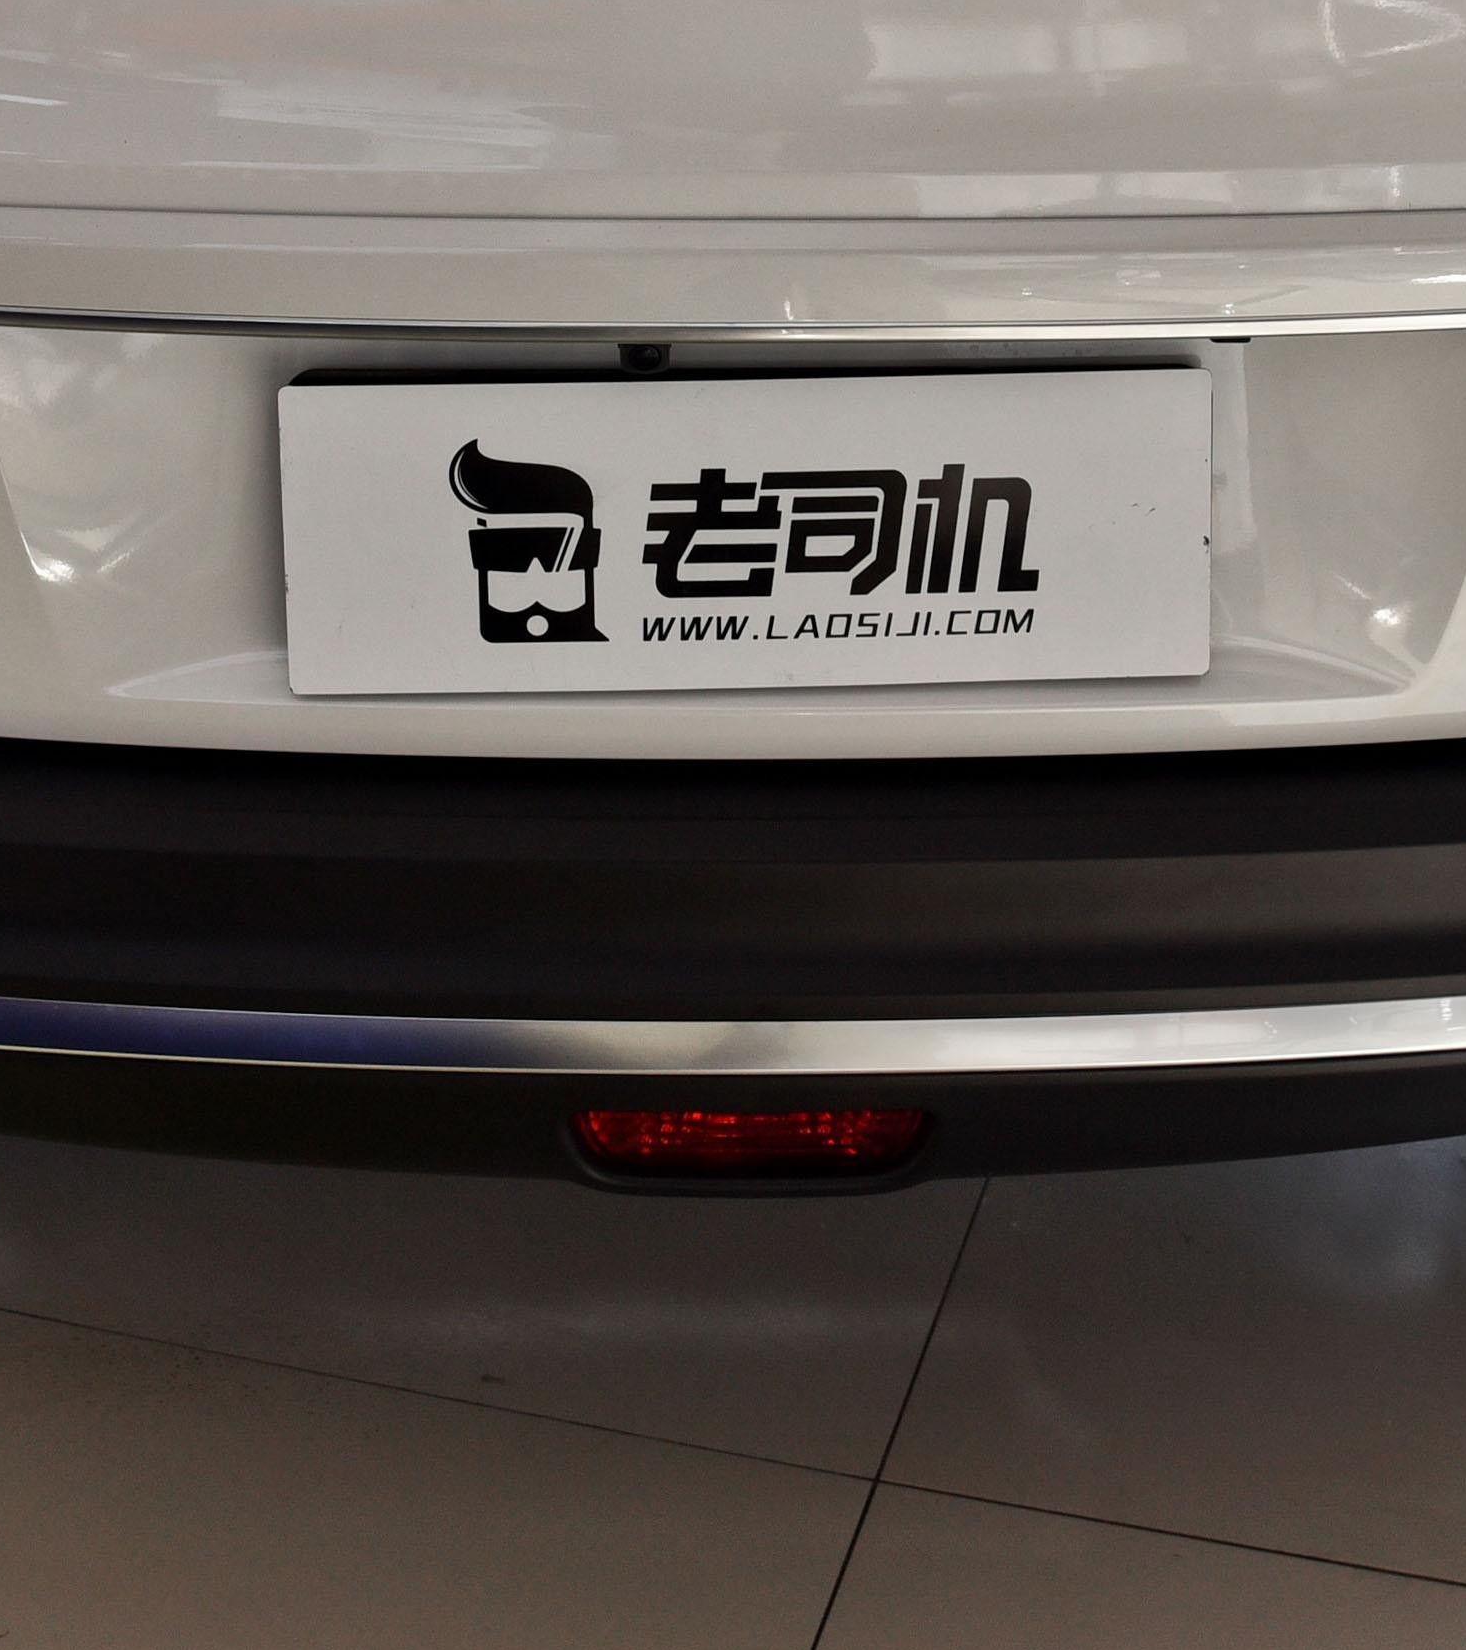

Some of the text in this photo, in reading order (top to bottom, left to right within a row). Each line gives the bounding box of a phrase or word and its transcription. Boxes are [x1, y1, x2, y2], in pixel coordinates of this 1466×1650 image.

[640, 463, 1040, 599] 老司机
[640, 607, 1036, 643] WWW.LAOSIJI.COM
